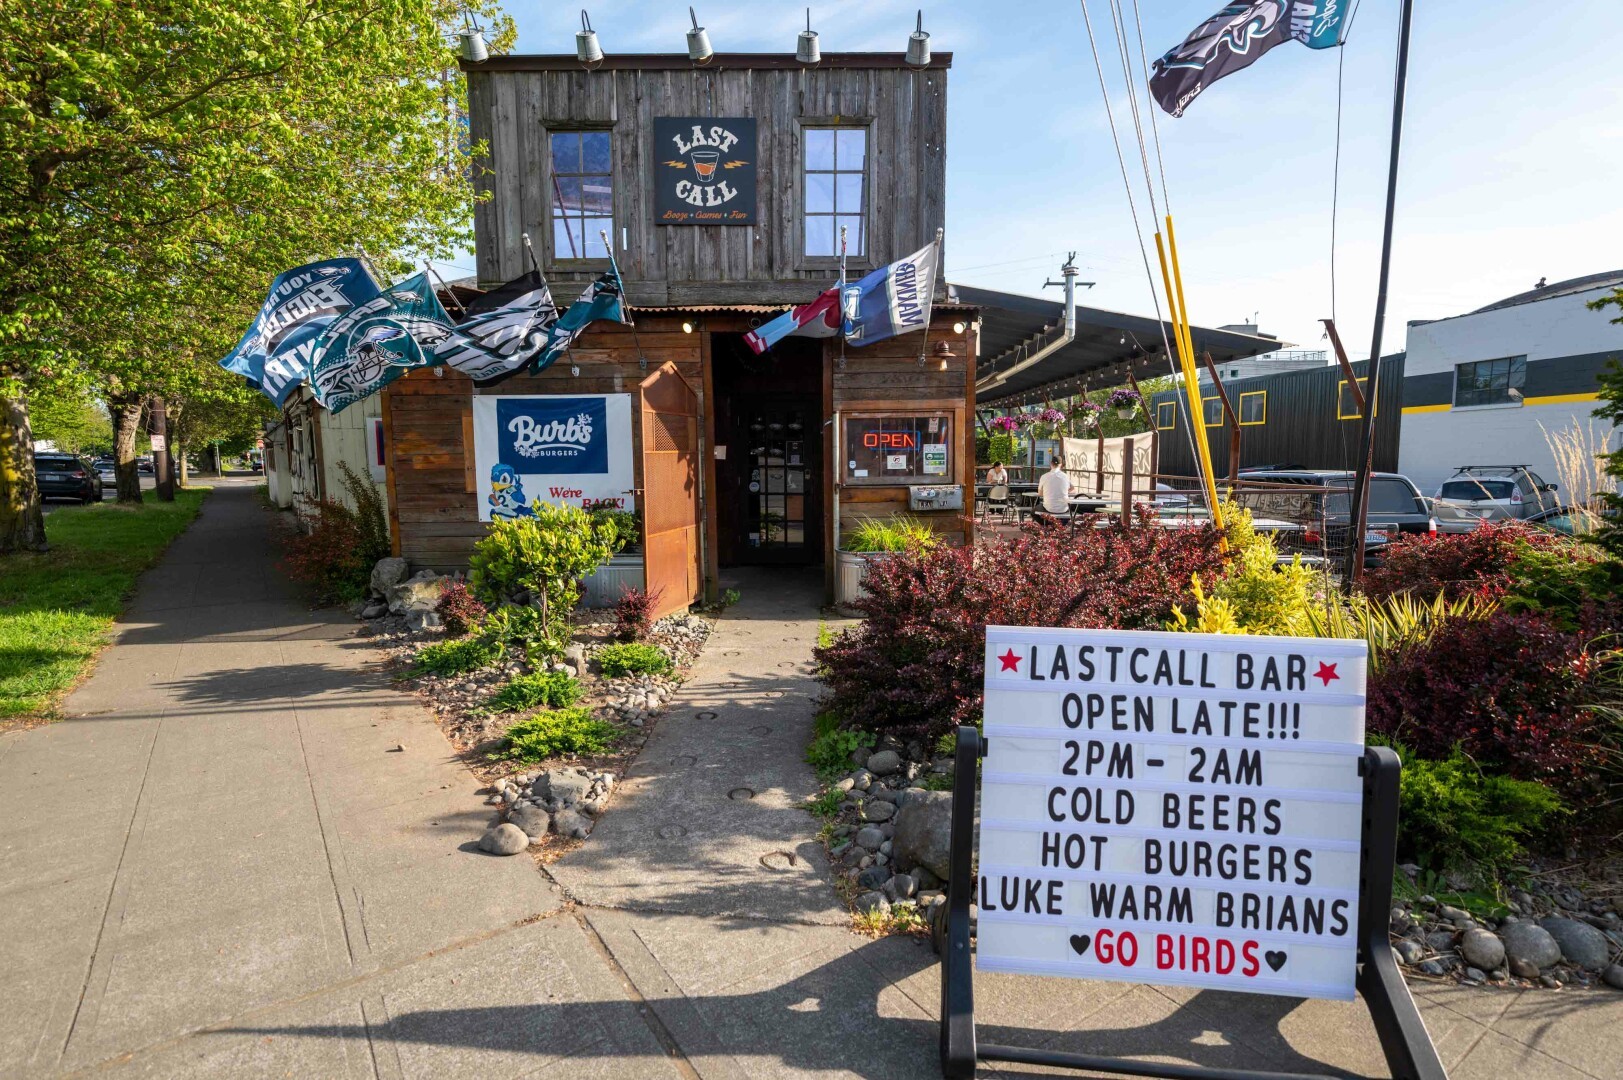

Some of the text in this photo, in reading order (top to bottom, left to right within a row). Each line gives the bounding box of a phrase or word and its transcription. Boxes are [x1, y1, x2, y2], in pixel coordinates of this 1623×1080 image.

[672, 125, 739, 155] LAST
[675, 180, 738, 207] CALL
[695, 210, 722, 219] Games
[729, 210, 748, 219] Fun
[863, 433, 915, 448] OPEN
[549, 487, 582, 498] We're
[1236, 653, 1306, 692] BAR
[1062, 692, 1301, 740] OPEN LATE!!!
[1062, 740, 1134, 779] 2PM
[1188, 746, 1263, 787] 2AM
[1047, 786, 1282, 836] COLD BEERS
[1041, 831, 1312, 886] HOT BURGERS
[981, 875, 1349, 937] LUKE WARM BRIANS
[1094, 929, 1260, 977] GO BIRDS
